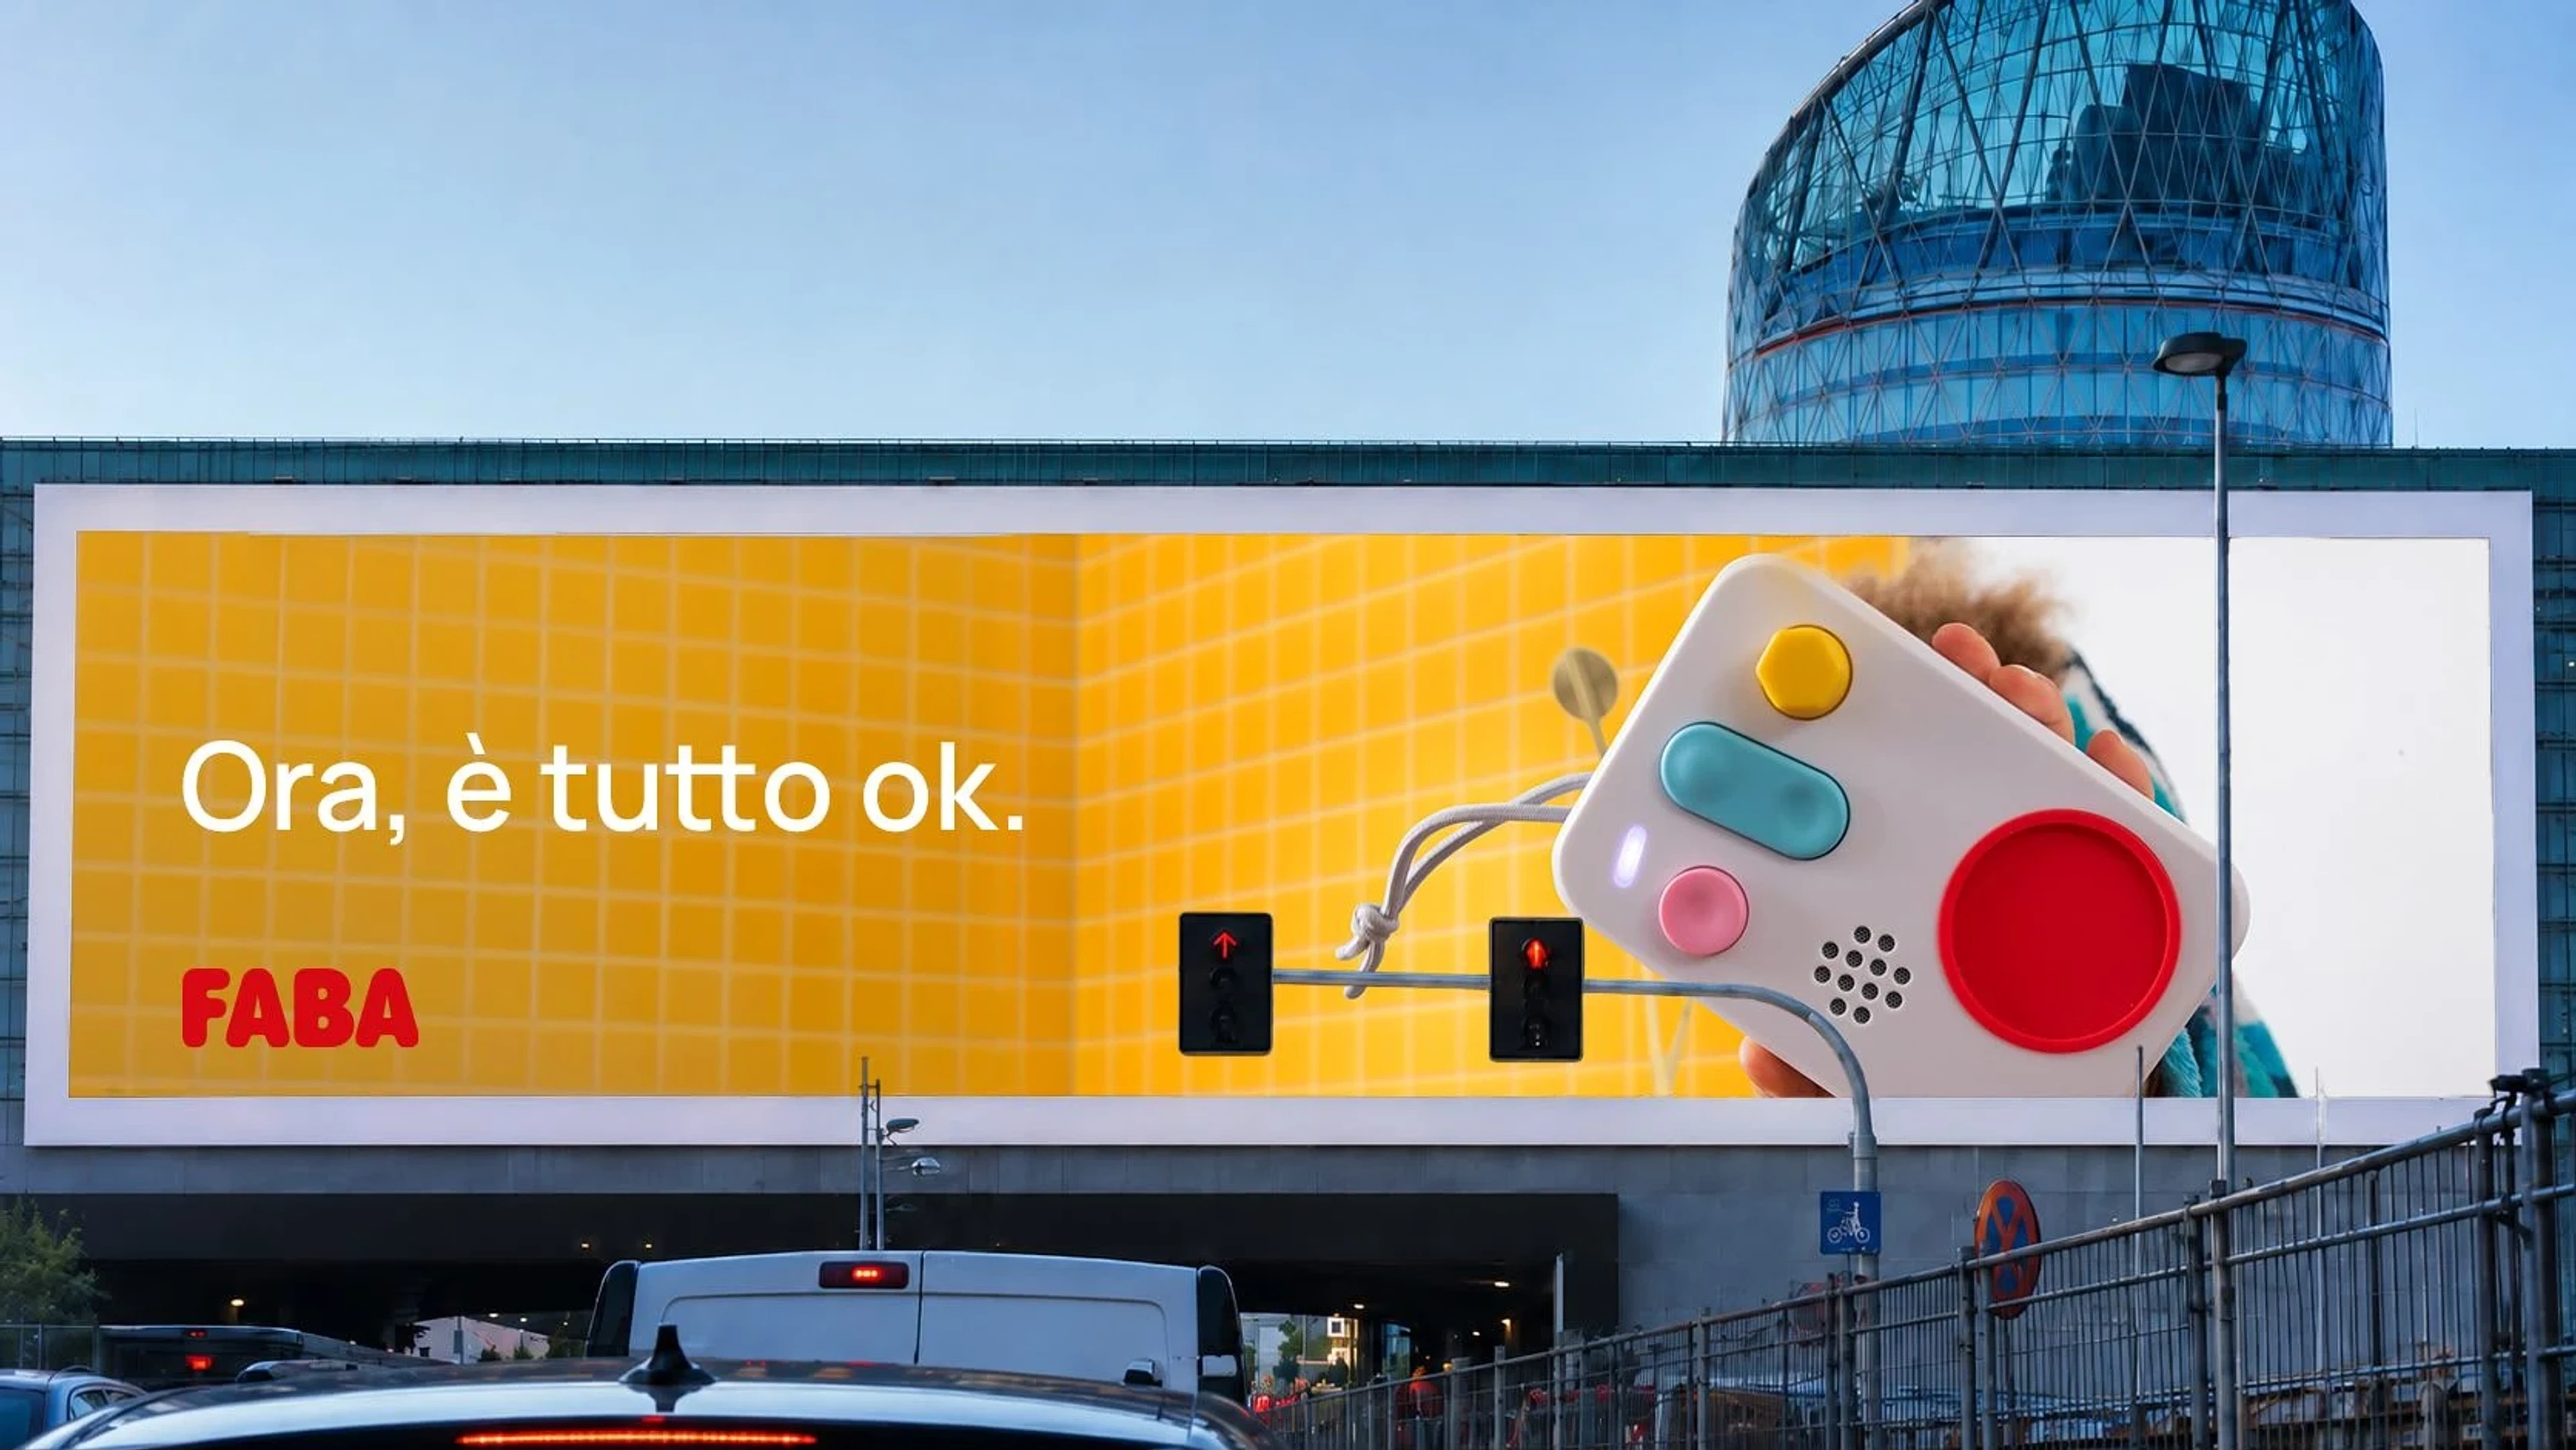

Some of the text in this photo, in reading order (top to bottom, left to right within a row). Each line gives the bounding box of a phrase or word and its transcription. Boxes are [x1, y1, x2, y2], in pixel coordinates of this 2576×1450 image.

[182, 733, 1023, 845] Ora, è tutto ok.
[182, 968, 419, 1049] FABA
